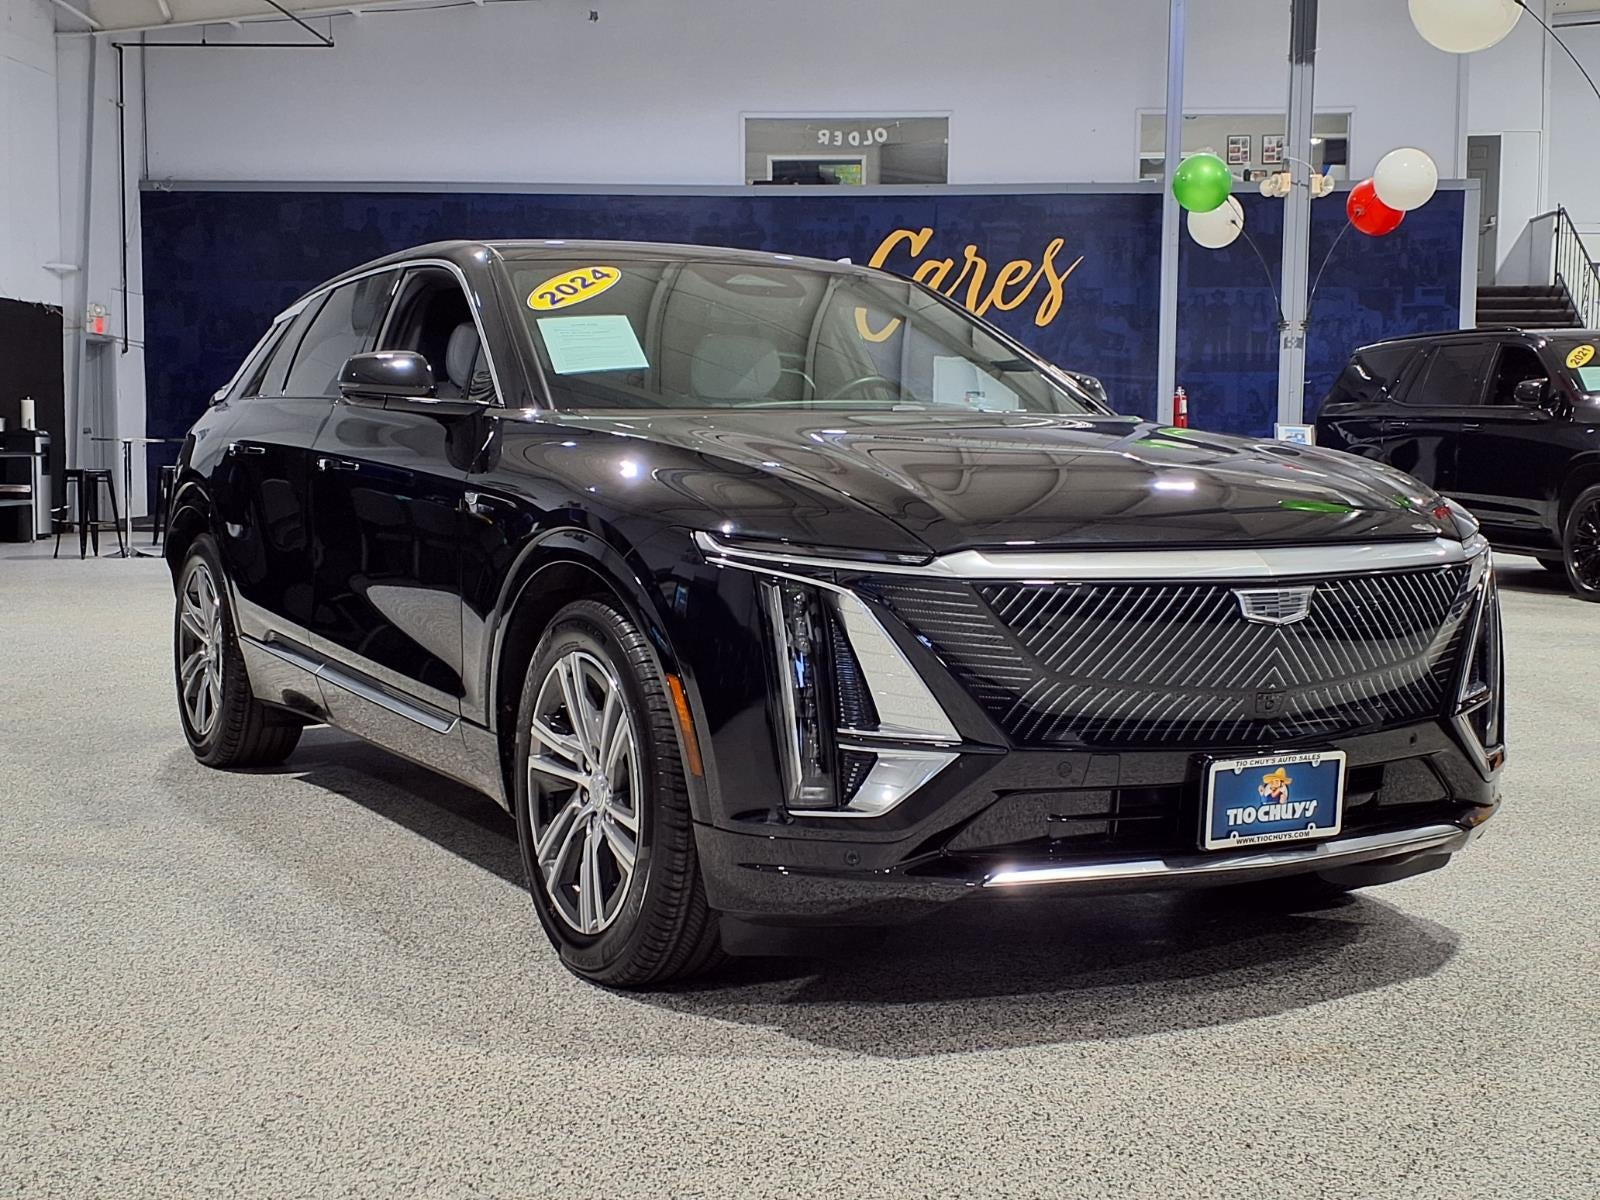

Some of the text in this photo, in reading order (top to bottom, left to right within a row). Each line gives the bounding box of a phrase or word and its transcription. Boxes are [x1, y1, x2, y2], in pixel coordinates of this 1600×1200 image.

[538, 268, 612, 306] 2024
[1570, 347, 1592, 366] 2021
[1249, 757, 1276, 766] CHUY'S
[1279, 755, 1297, 764] AUTO
[1299, 753, 1321, 761] SALES
[1226, 799, 1318, 826] TIO CHUY'S
[1236, 830, 1311, 845] WWW.TIOCHUYS.COM
